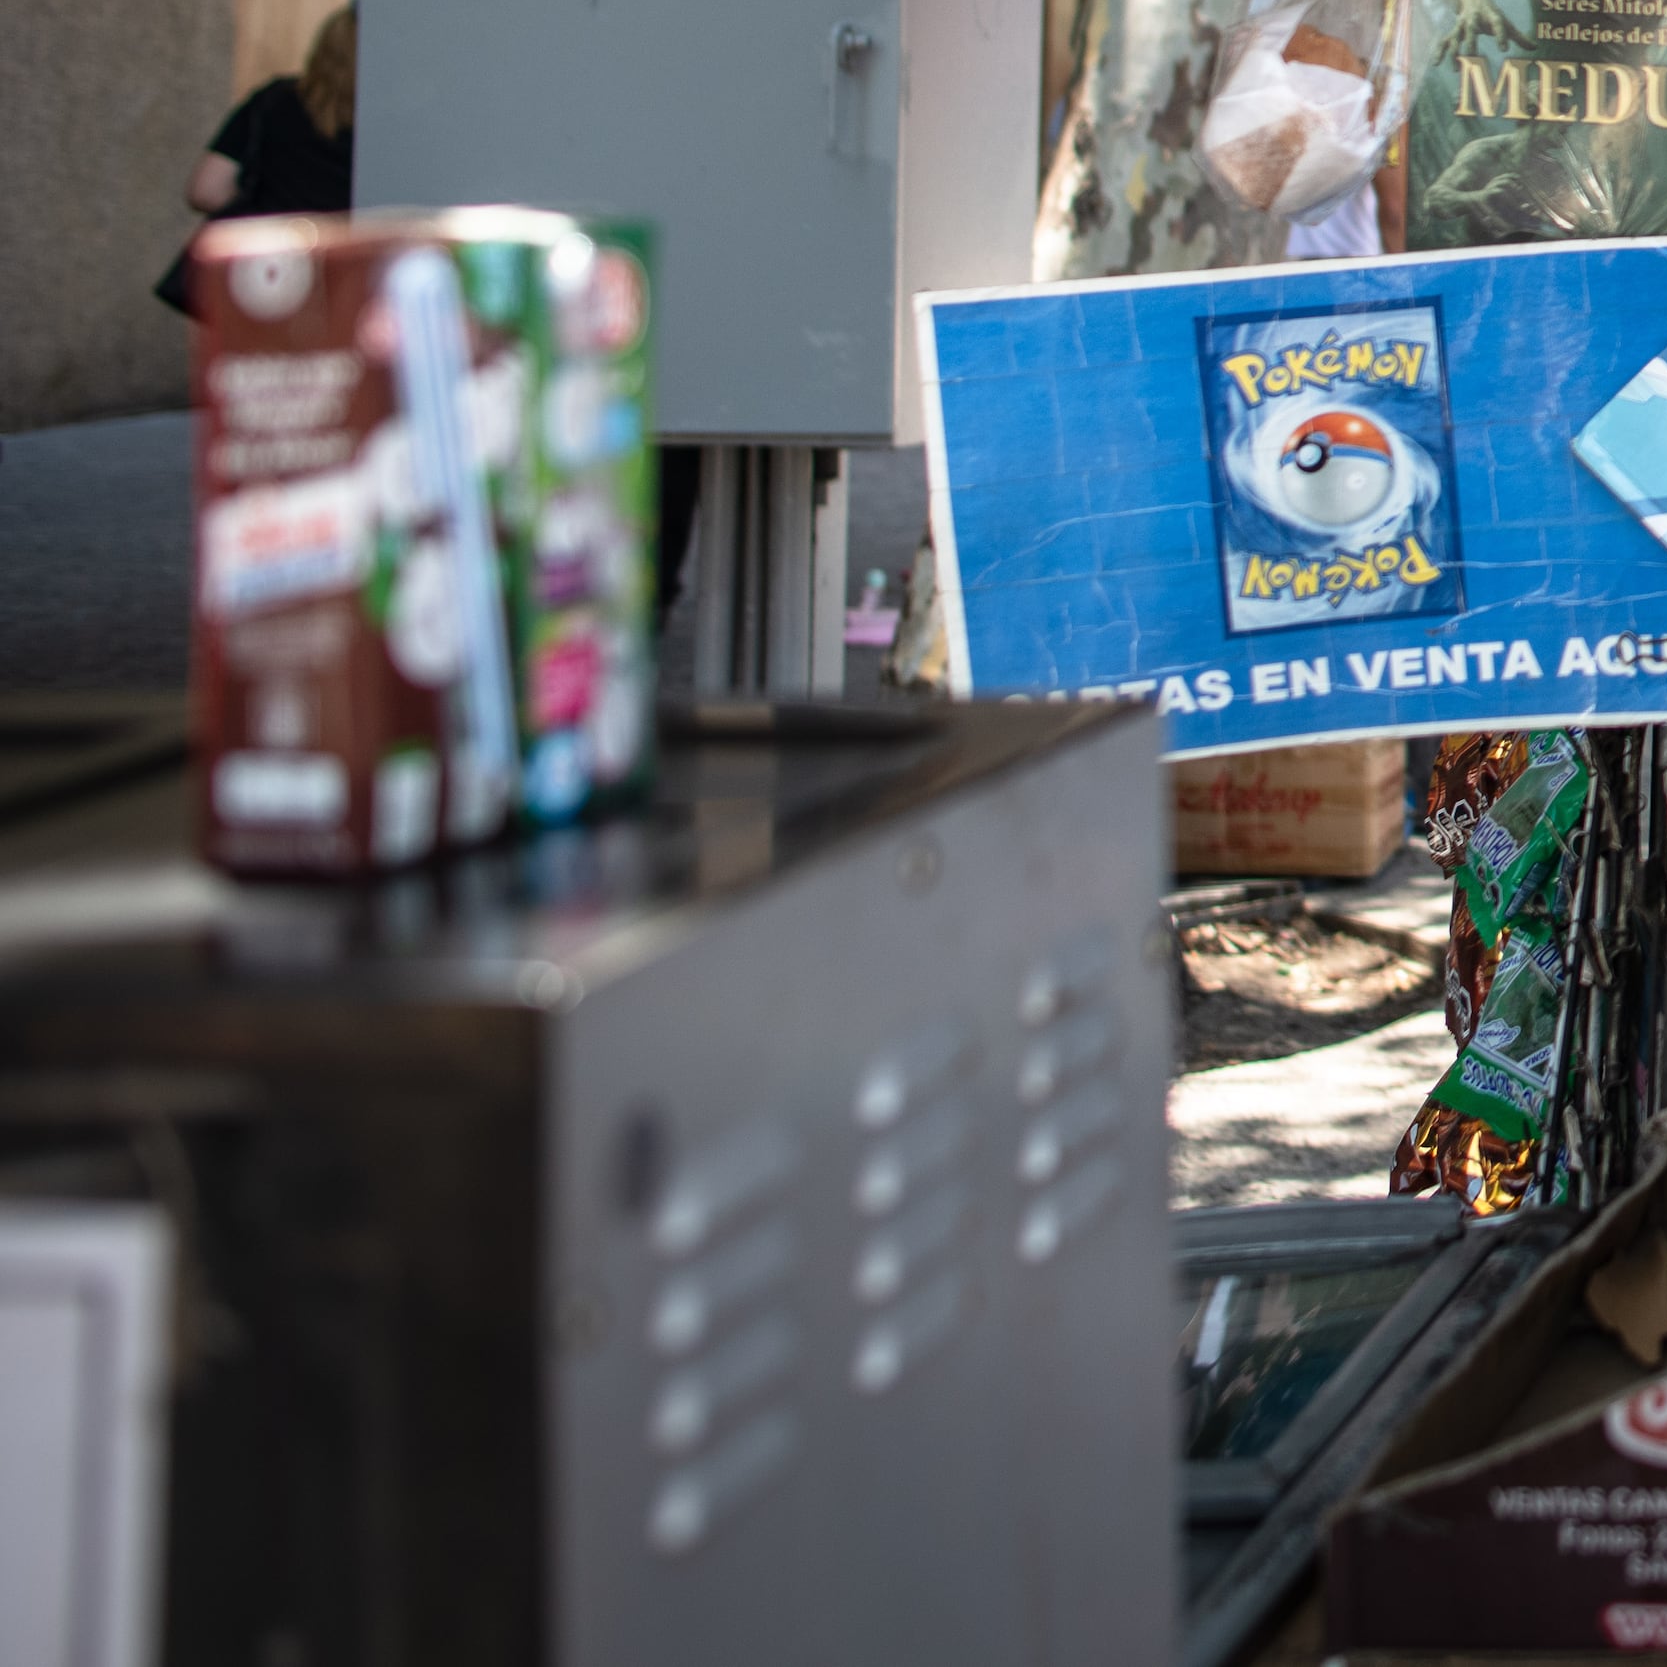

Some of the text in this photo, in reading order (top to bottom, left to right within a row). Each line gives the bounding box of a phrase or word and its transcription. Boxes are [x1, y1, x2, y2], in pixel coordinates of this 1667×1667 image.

[1536, 21, 1624, 45] Reflejos
[1626, 26, 1651, 45] de
[1250, 656, 1330, 704] EN
[1346, 640, 1543, 693] VENTA
[1468, 813, 1518, 875] MENTHOL
